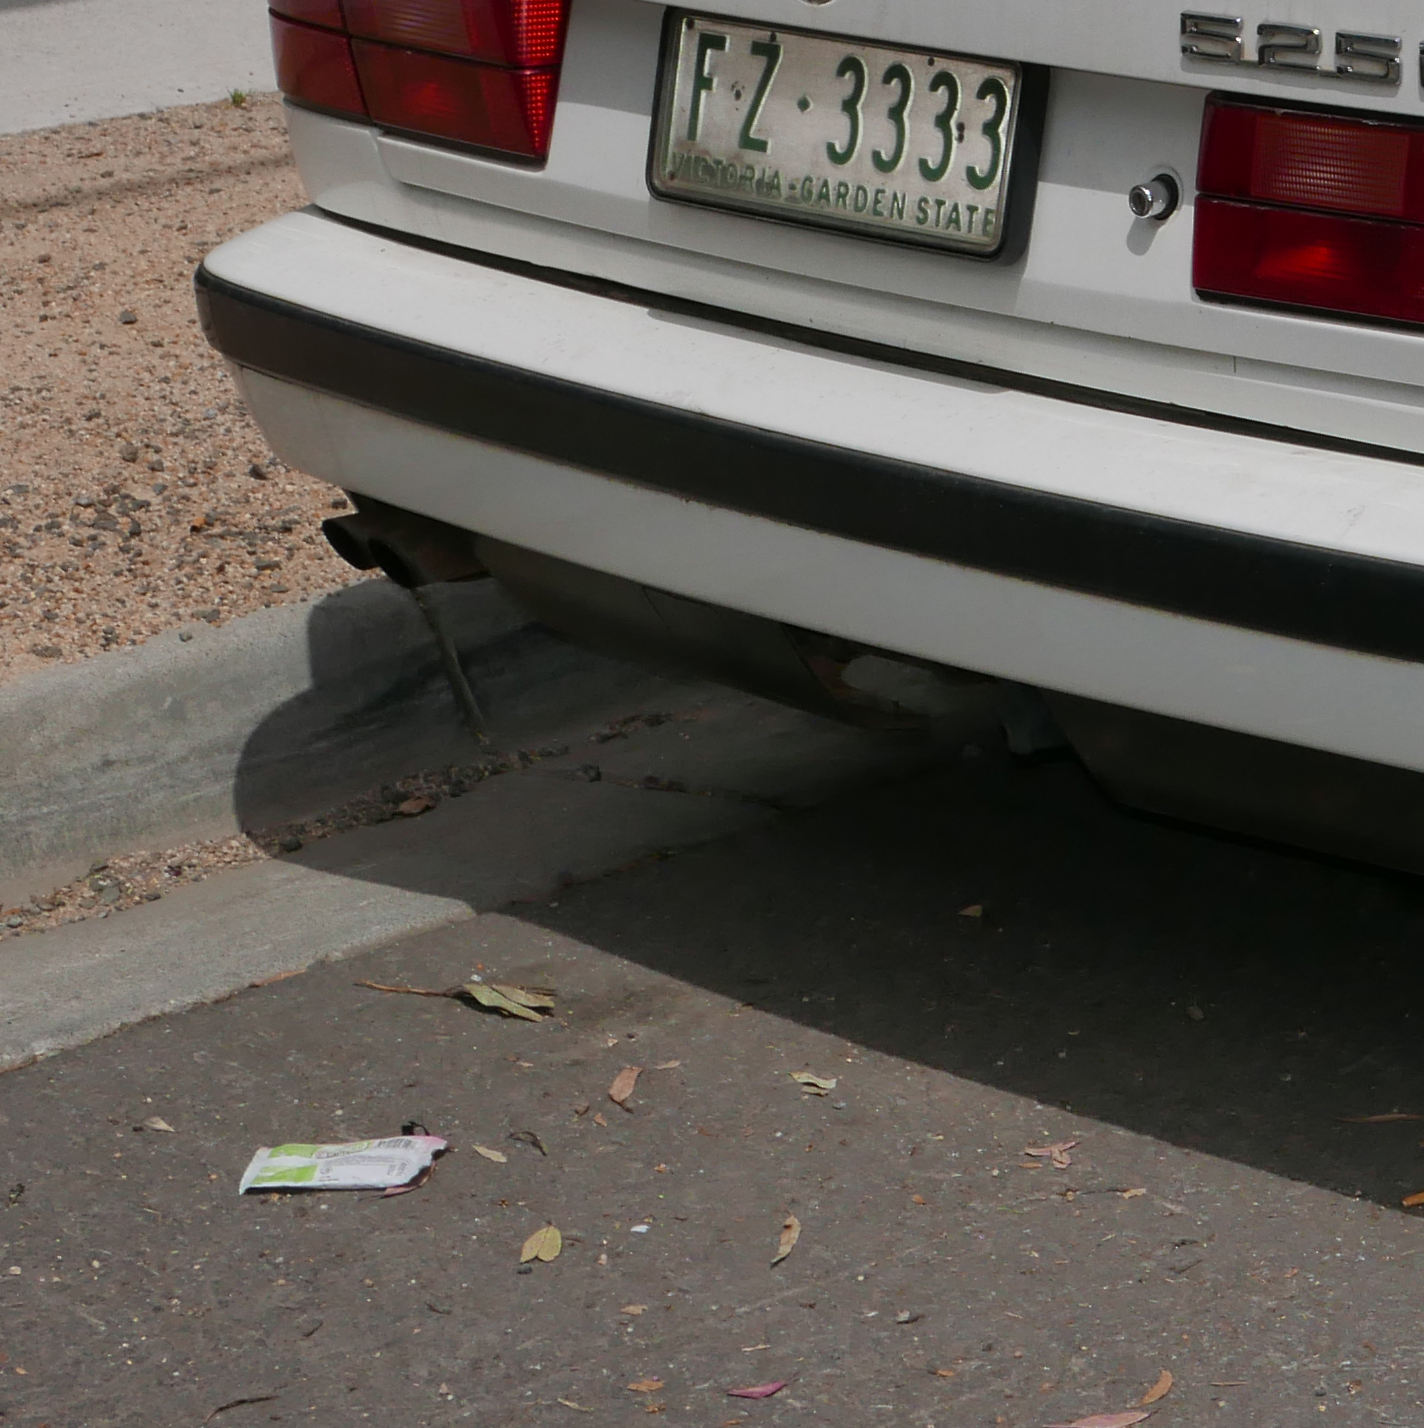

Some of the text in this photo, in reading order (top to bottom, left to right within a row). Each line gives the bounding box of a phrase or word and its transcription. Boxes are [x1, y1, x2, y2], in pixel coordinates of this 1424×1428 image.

[671, 152, 996, 236] VICTORIA GARDEN STATE
